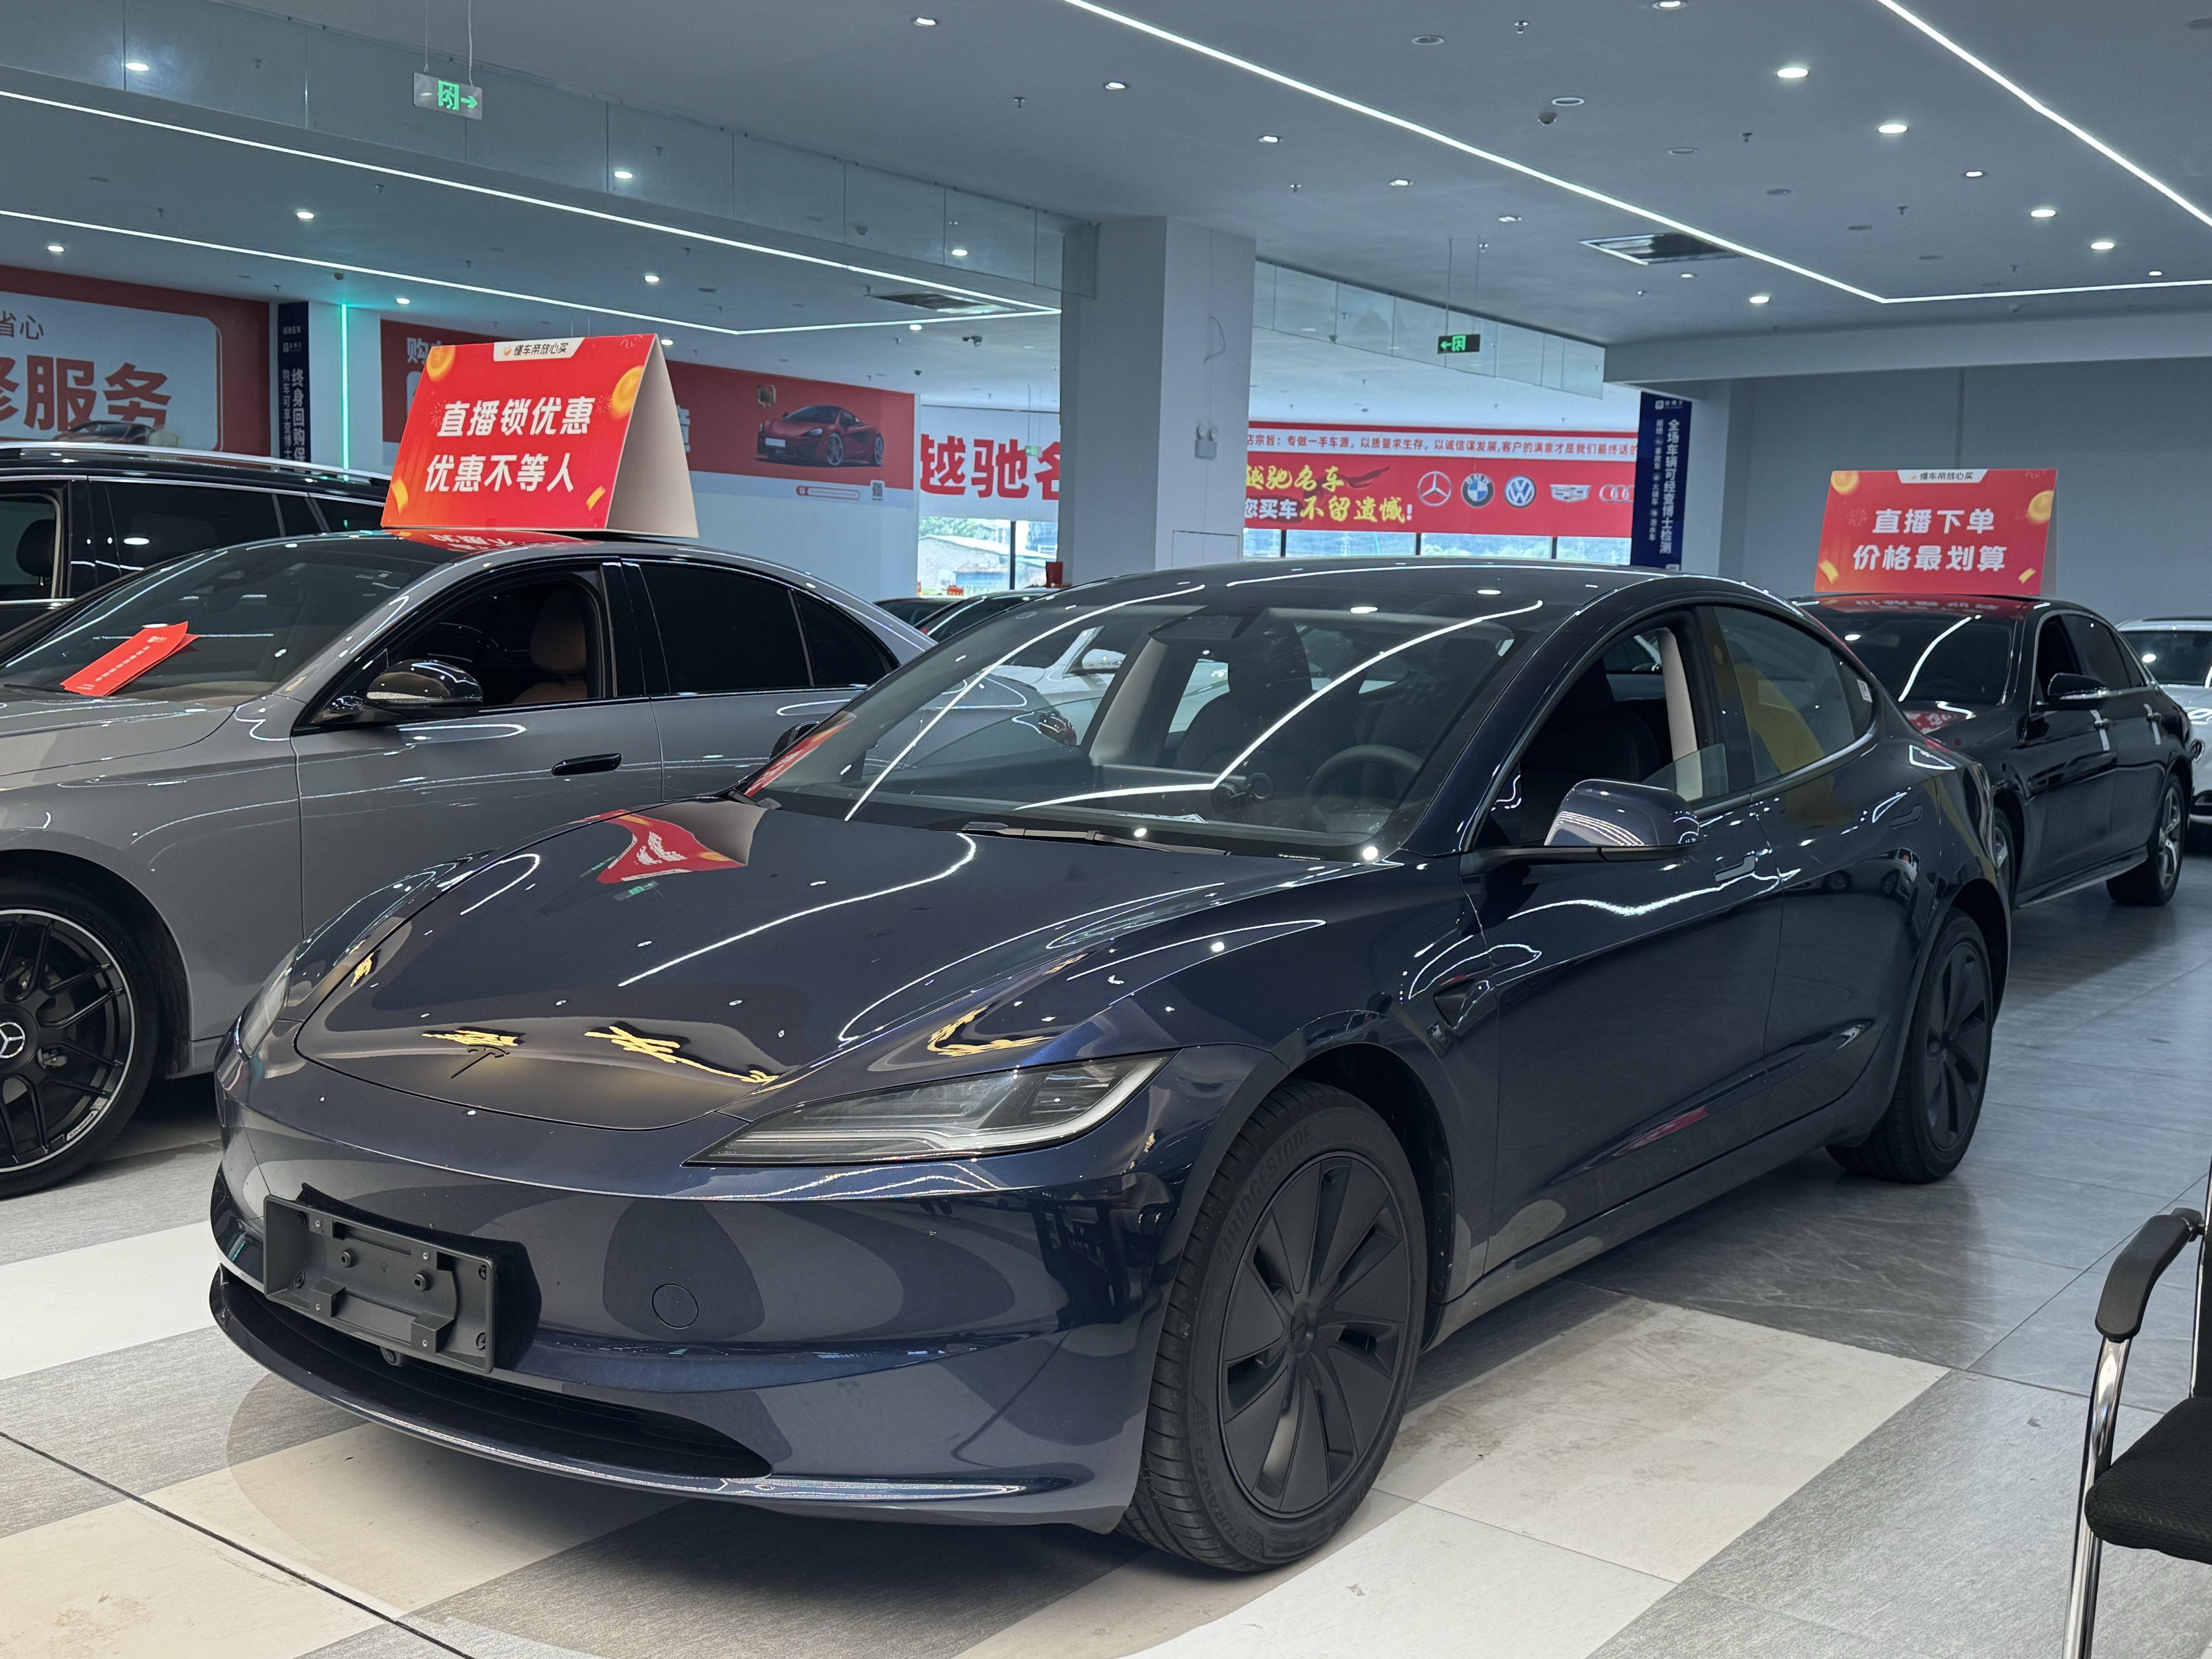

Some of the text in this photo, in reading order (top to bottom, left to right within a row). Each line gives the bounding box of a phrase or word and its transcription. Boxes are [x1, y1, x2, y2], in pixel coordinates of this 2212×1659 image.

[0, 311, 44, 340] 省心
[406, 337, 441, 364] 购
[514, 342, 568, 356] 懂车帝放心买
[292, 368, 306, 473] 终身回购保
[436, 396, 596, 437] 直播锁优惠
[424, 452, 575, 493] 优惠不等人
[1246, 465, 1344, 492] 越驰名车
[1920, 472, 1973, 480] 懂车帝放心买
[1872, 508, 1994, 534] 直播下单
[1853, 544, 2007, 572] 价格最划算
